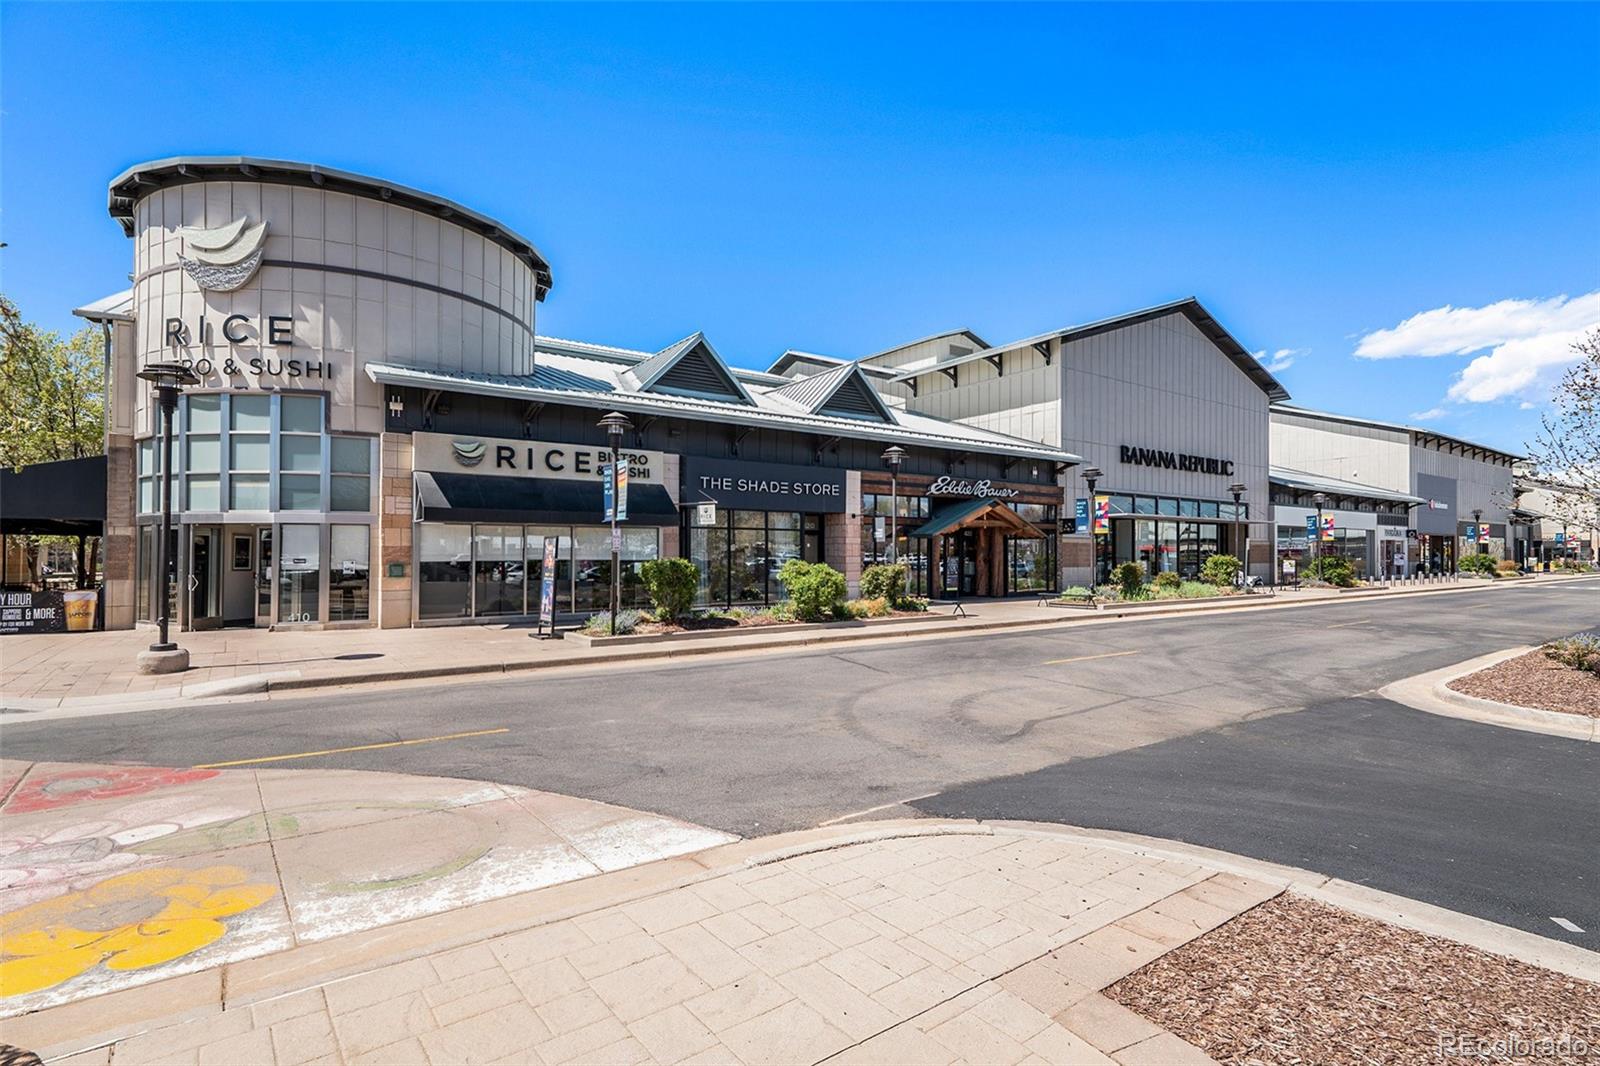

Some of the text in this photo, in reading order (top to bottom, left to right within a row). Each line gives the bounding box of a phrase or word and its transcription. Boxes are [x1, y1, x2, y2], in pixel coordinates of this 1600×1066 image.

[166, 314, 293, 346] RICE
[223, 358, 238, 375] &
[249, 358, 332, 379] SUSHI
[496, 445, 591, 473] RICE
[598, 451, 648, 465] BITRO
[1120, 445, 1234, 476] BANANA REPUBLIC
[700, 476, 840, 496] THE SHADE STORE
[926, 476, 1019, 498] Eddie Bauer
[8, 593, 32, 606] HOUR
[25, 607, 56, 620] & MORE
